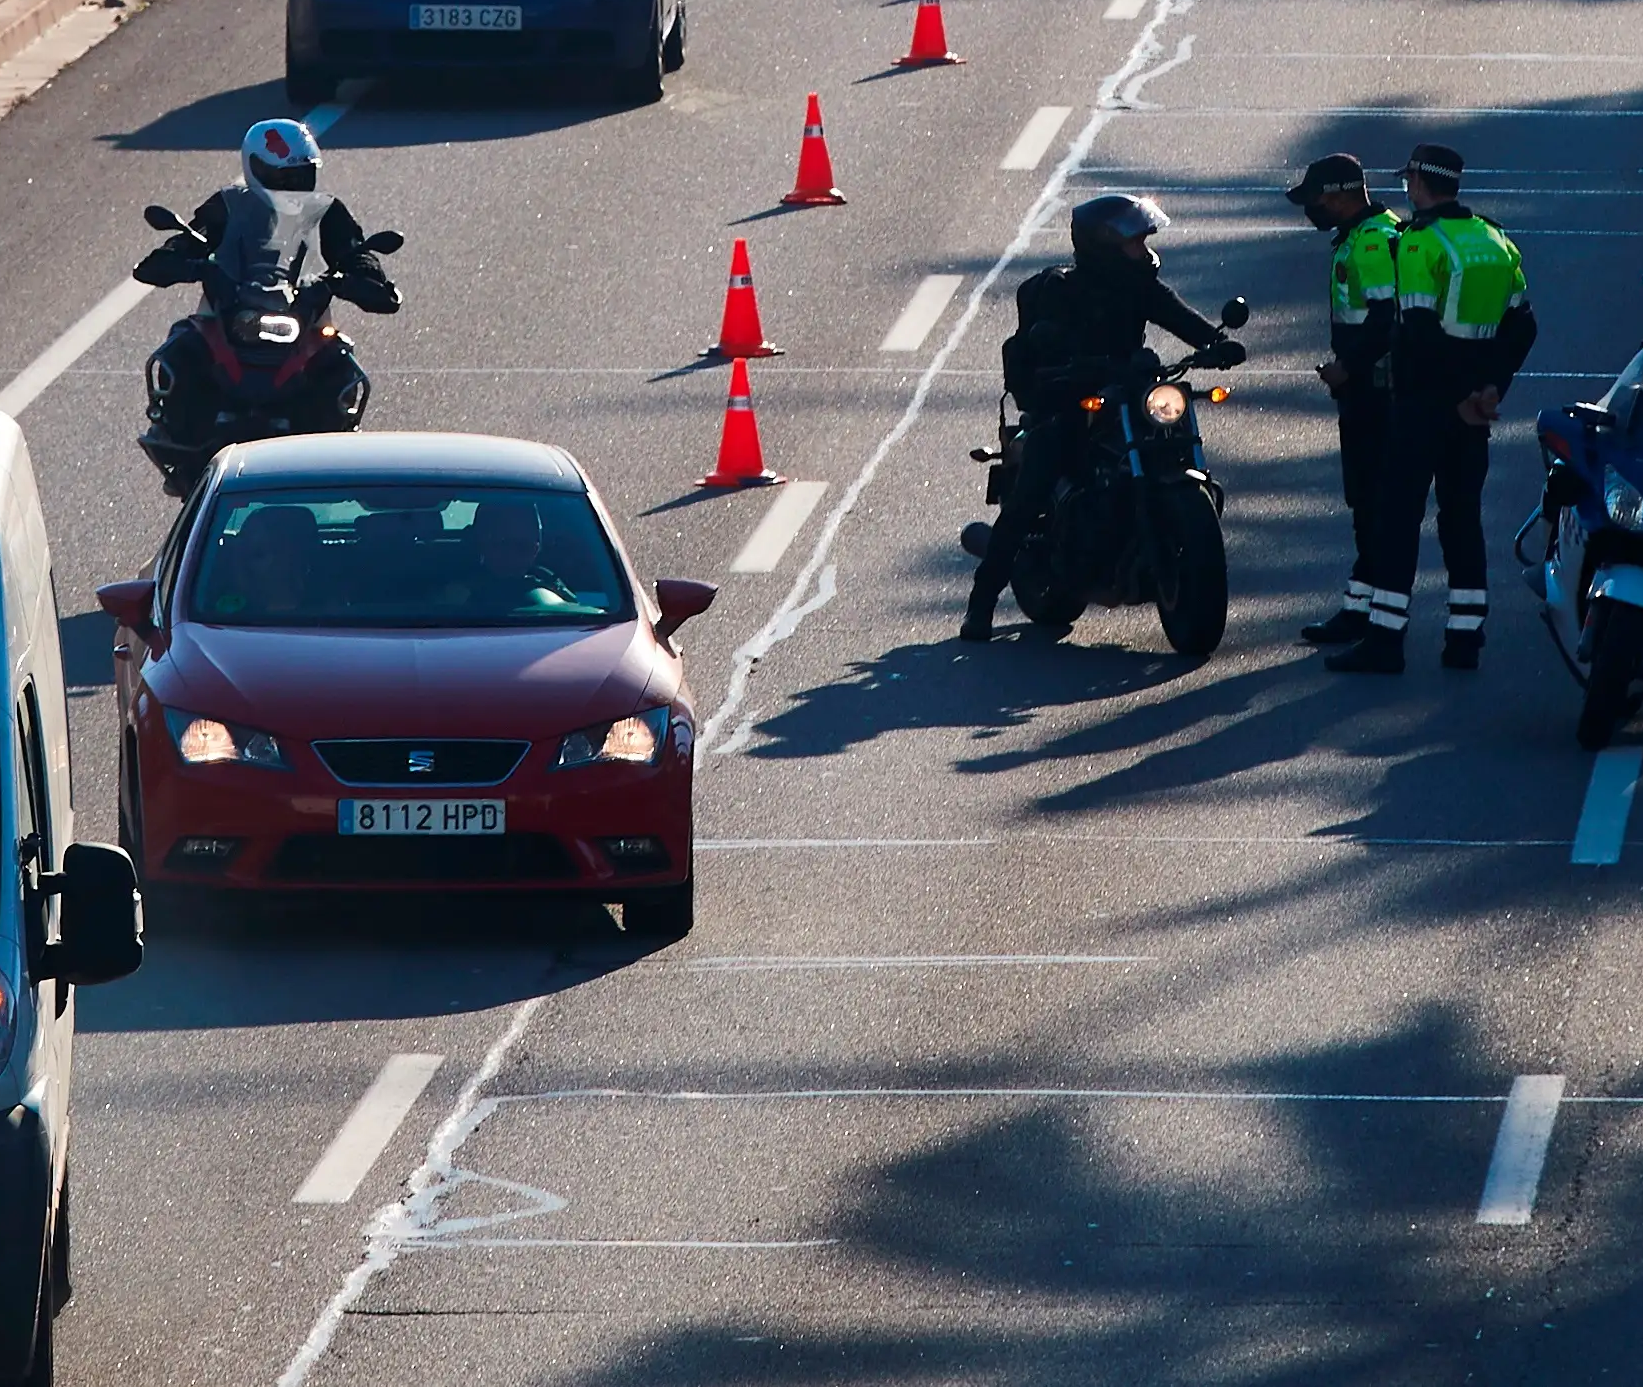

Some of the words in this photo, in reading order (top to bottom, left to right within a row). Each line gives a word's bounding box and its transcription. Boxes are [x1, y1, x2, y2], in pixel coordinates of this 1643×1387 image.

[423, 9, 473, 26] 3183
[479, 9, 517, 27] CZG
[359, 804, 432, 830] 8112
[443, 804, 498, 830] HPD
